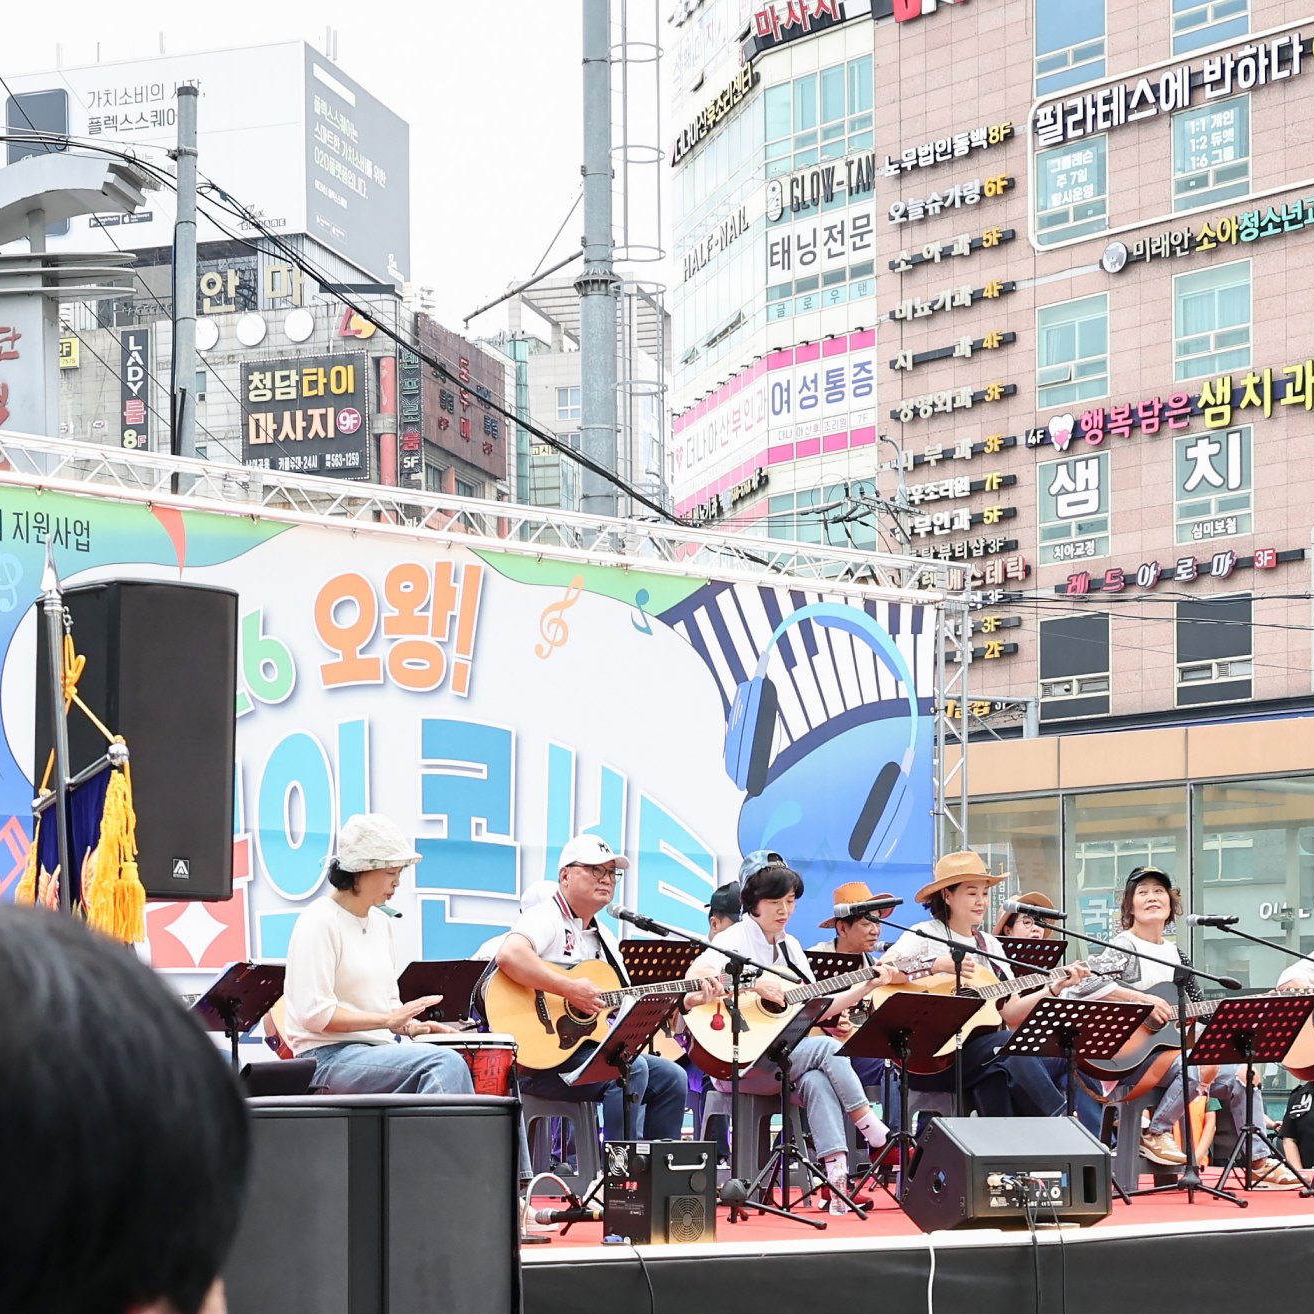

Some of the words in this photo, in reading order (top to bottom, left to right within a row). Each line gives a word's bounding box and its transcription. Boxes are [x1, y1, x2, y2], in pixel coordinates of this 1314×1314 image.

[87, 82, 165, 110] 가치소비의
[1036, 65, 1191, 147] 필라테스에
[1203, 33, 1304, 100] 반하다
[1189, 117, 1206, 135] 1:1
[1210, 109, 1235, 129] 개인
[884, 126, 989, 178] 노무법인동백
[988, 122, 1013, 145] 8F
[1190, 136, 1208, 152] 1:2
[1190, 154, 1209, 172] 1:6
[788, 153, 876, 214] GLOW-TAN
[1070, 168, 1088, 185] 7일
[888, 178, 982, 226] 오늘슈가링
[983, 173, 1009, 198] 6F
[769, 212, 874, 272] 태닝전문
[982, 226, 1003, 248] 5F
[1133, 227, 1192, 264] 미래안
[982, 278, 1004, 299] 4F
[982, 329, 1004, 350] 4F
[247, 364, 355, 403] 청담타이
[771, 360, 875, 417] 여성통증
[983, 381, 1005, 403] 3F
[248, 406, 336, 446] 마사지
[338, 411, 360, 431] 9F
[1080, 390, 1194, 446] 행복담은
[122, 428, 147, 449] 8F
[983, 434, 1005, 455] 3F
[1026, 429, 1045, 446] 4F
[402, 456, 420, 468] 5F
[1182, 429, 1243, 493] 치
[983, 472, 1004, 492] 7F
[1047, 457, 1102, 520] 샘
[982, 505, 1004, 526] 5F
[11, 511, 92, 554] 지원사업
[1191, 517, 1238, 541] 심미보철
[987, 538, 1006, 555] 3F
[1052, 539, 1096, 561] 치아교정
[1254, 549, 1274, 568] 3F
[313, 560, 485, 699] 오왕!
[981, 615, 1003, 634] 3F
[984, 640, 1005, 660] 2F
